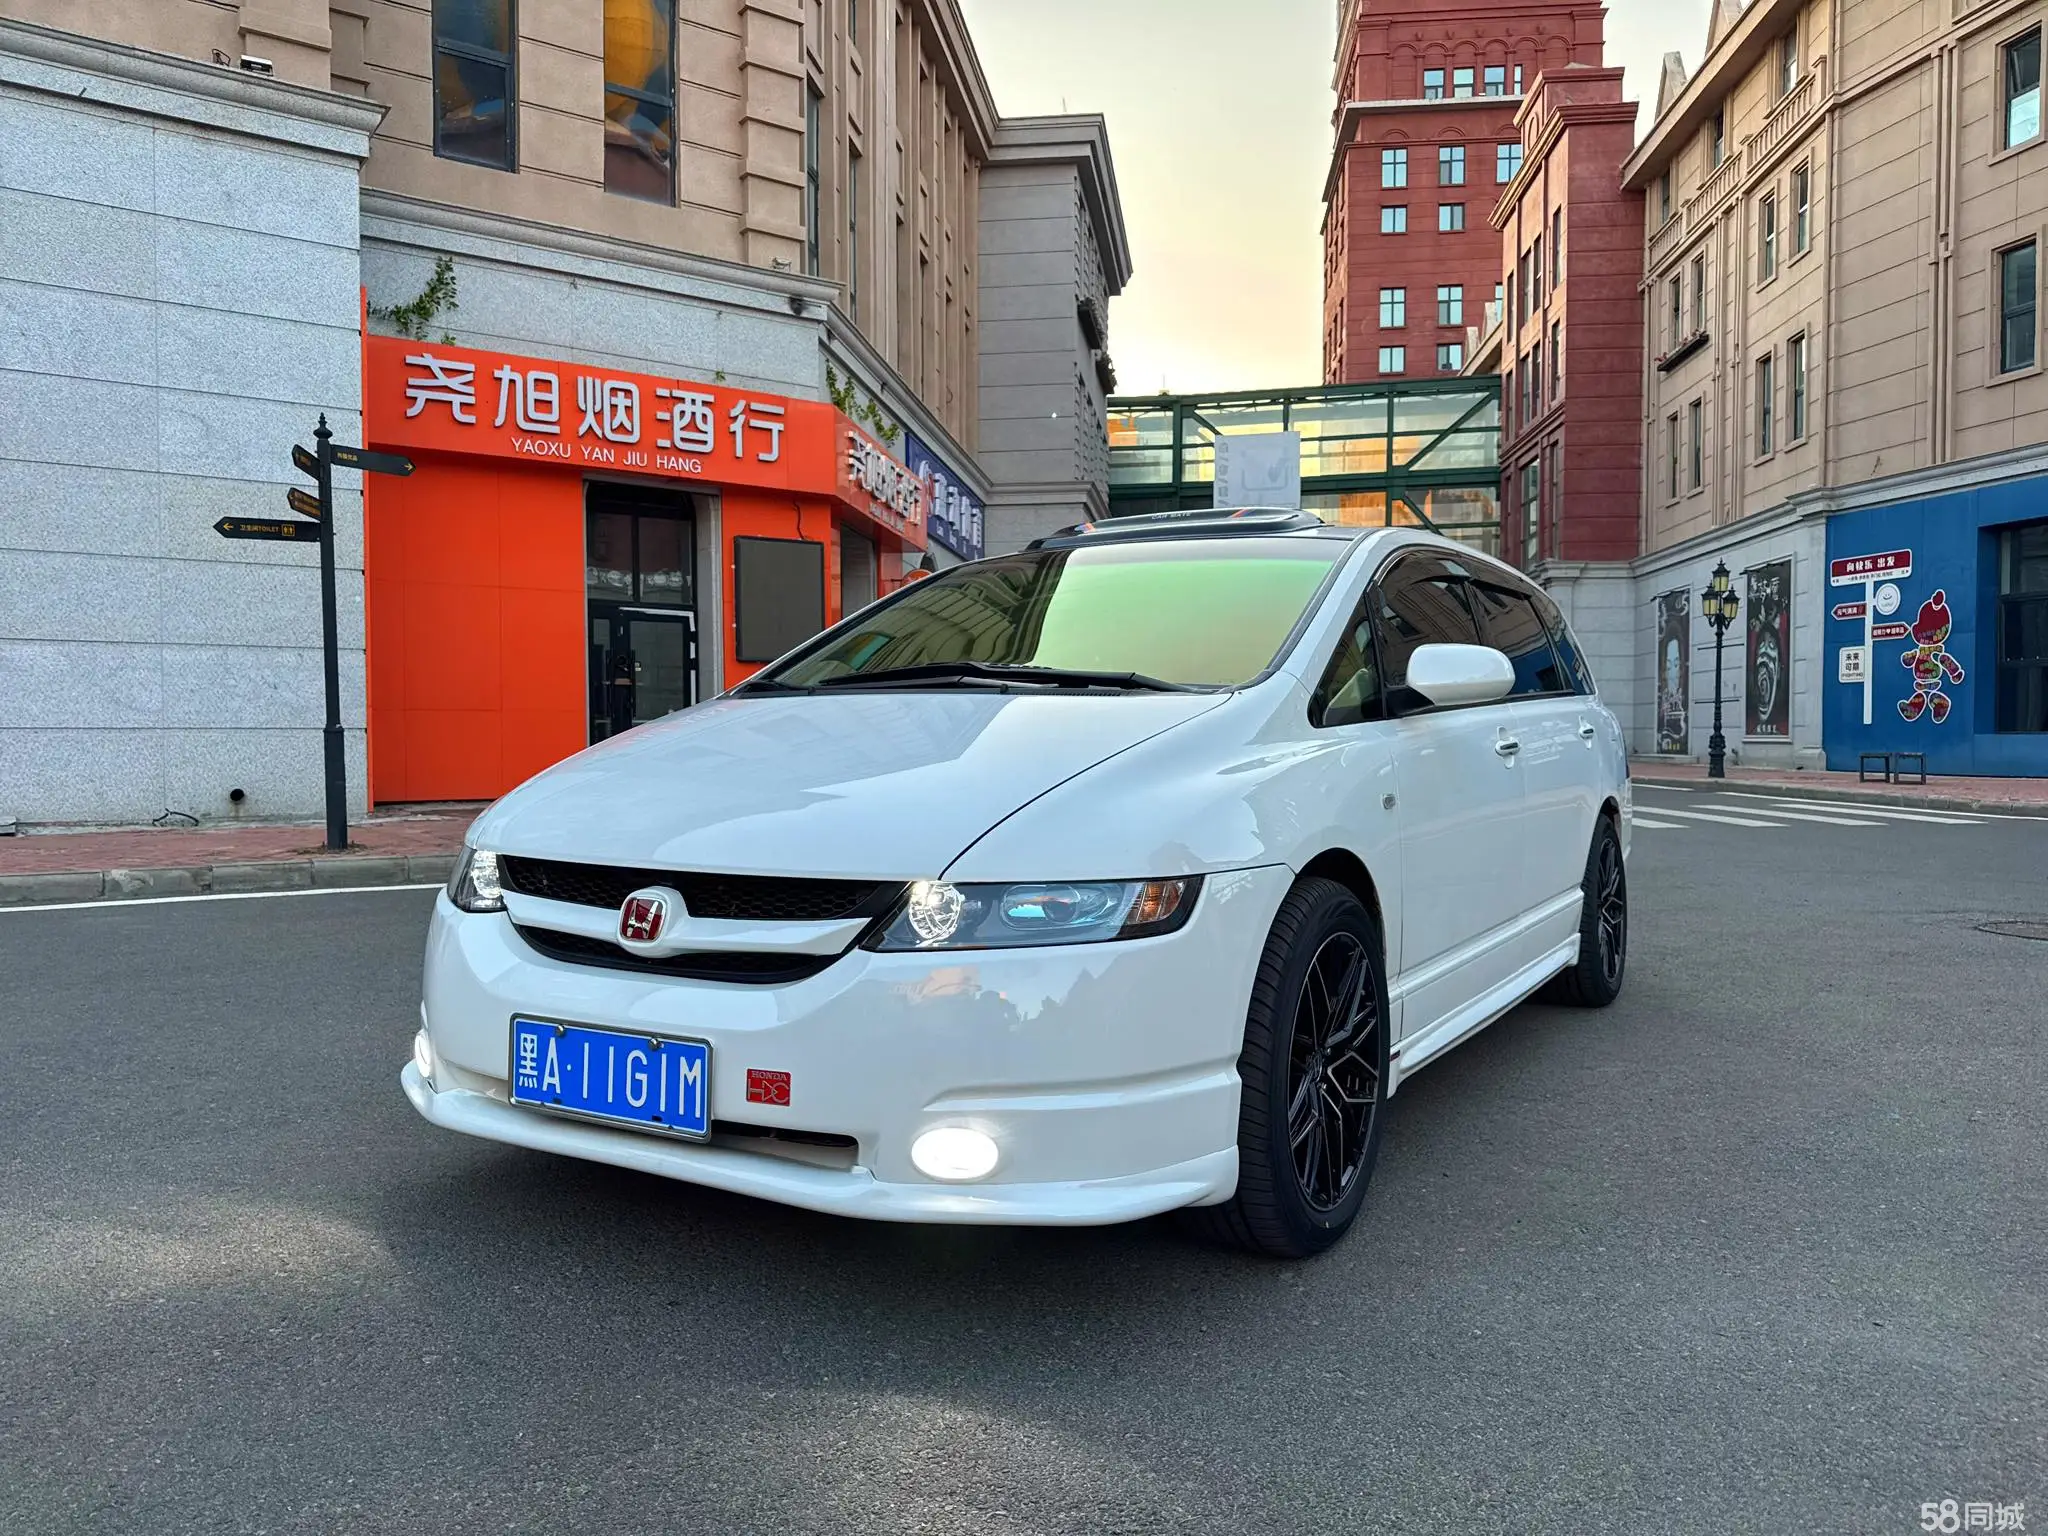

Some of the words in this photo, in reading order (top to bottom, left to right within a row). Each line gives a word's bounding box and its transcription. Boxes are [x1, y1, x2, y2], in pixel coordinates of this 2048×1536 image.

[404, 353, 785, 462] 尧旭烟酒行
[510, 436, 571, 460] YAOXU
[581, 444, 616, 463] YAN
[622, 450, 648, 468] JIU
[655, 454, 702, 474] HANG
[1877, 556, 1896, 568] 出发
[1845, 652, 1860, 662] 未来
[751, 1070, 787, 1081] HONDA
